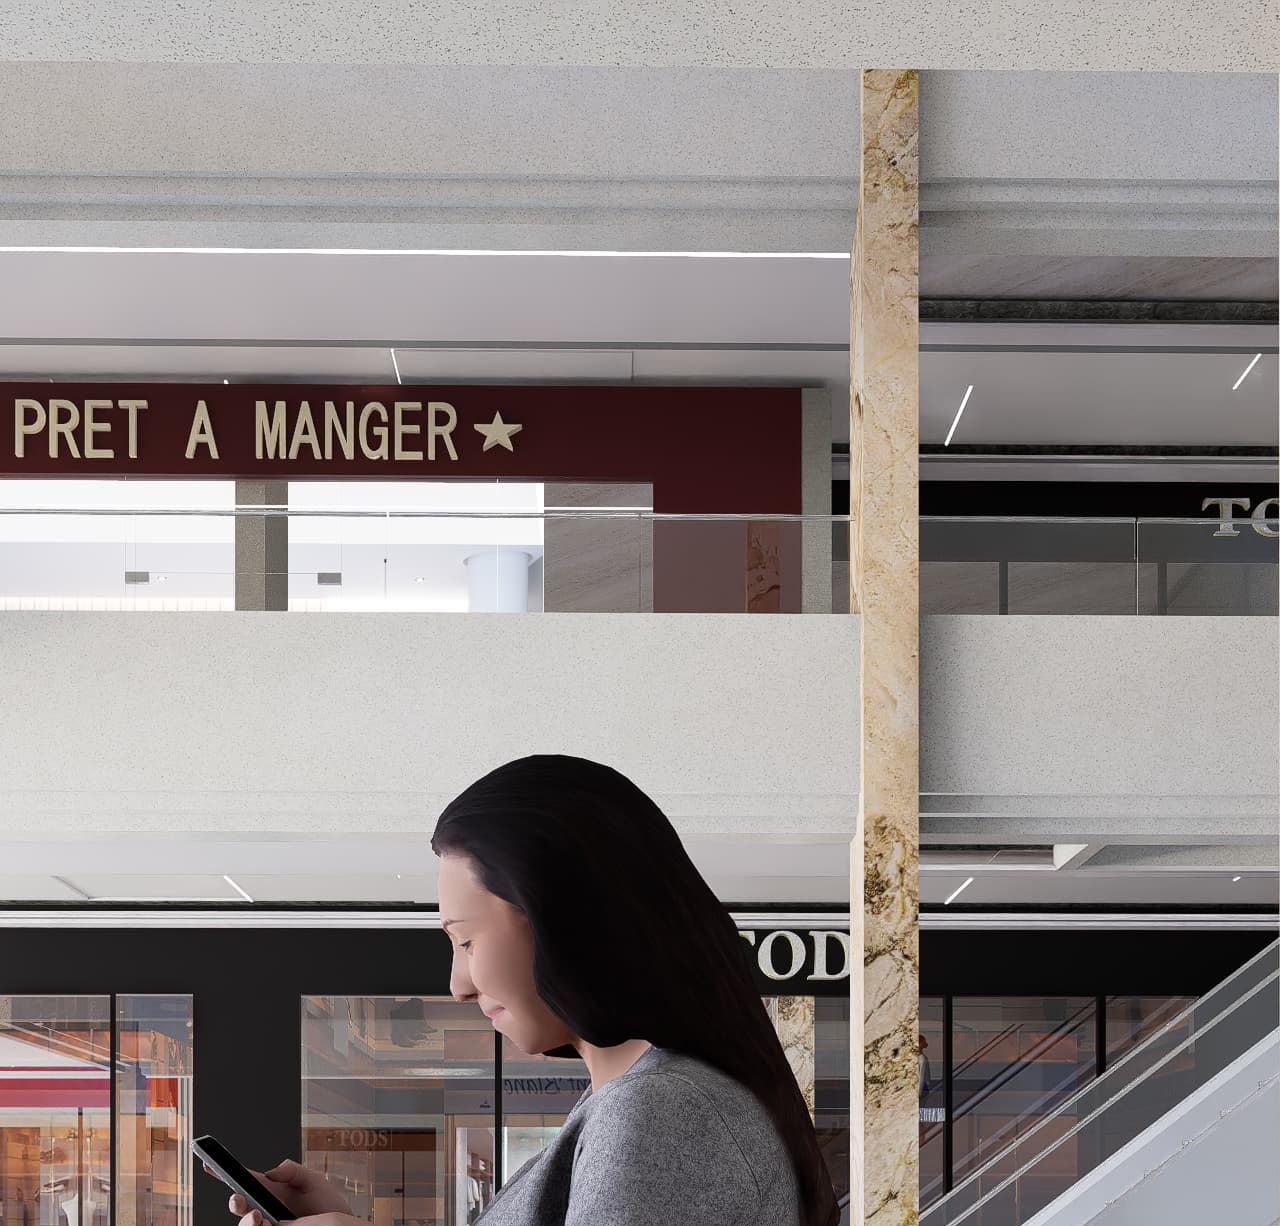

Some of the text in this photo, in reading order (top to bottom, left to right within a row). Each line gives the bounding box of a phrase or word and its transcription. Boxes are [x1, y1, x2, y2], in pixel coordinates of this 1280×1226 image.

[15, 399, 459, 460] PRET A MANGER
[738, 930, 851, 980] OD
[335, 1128, 388, 1147] TODS
